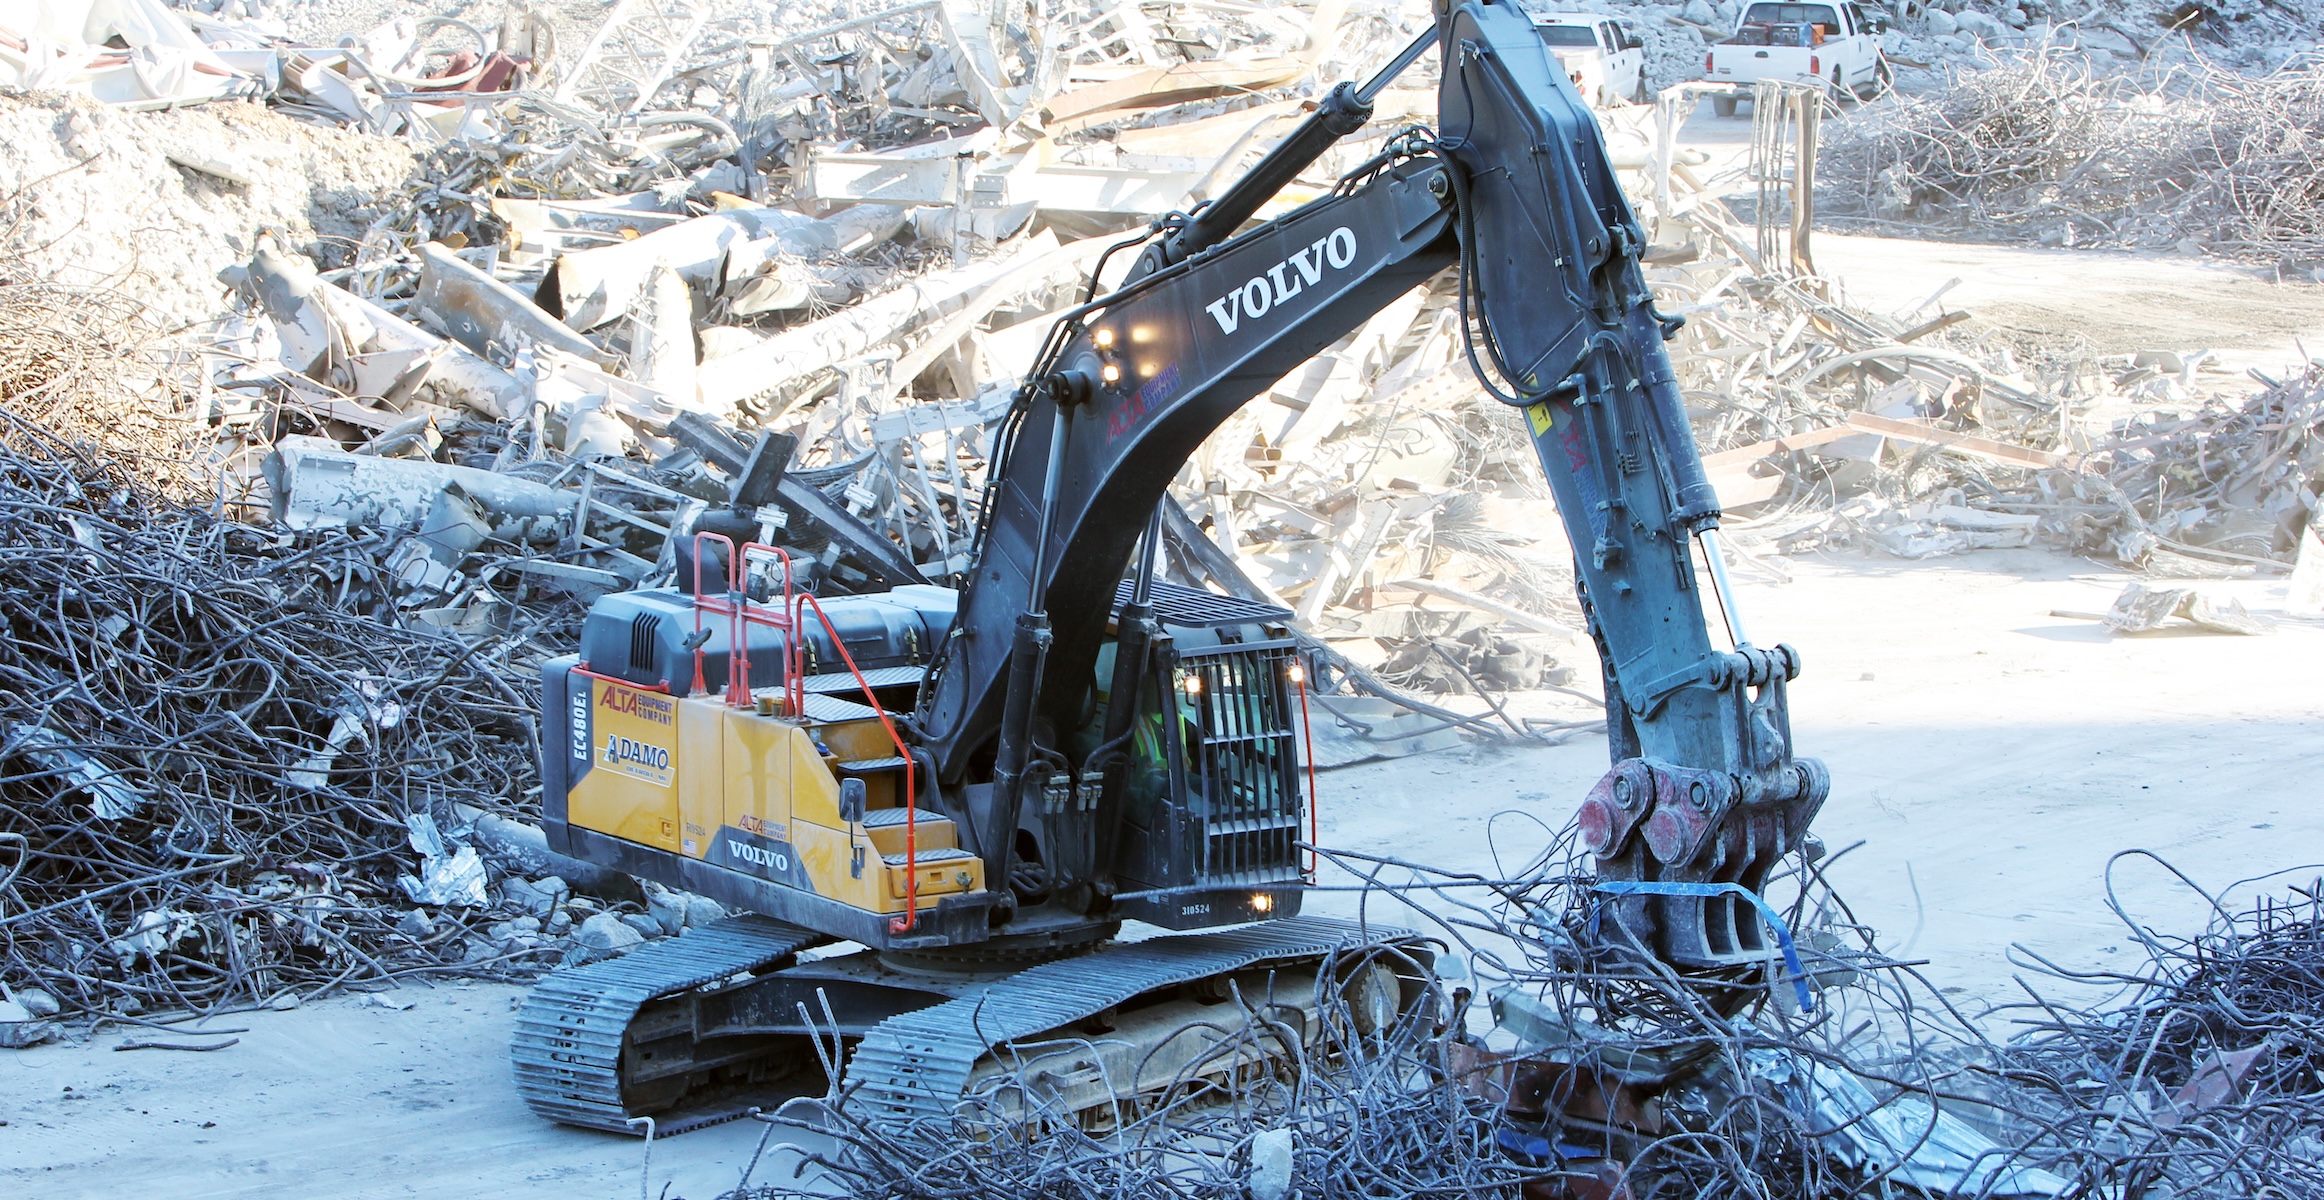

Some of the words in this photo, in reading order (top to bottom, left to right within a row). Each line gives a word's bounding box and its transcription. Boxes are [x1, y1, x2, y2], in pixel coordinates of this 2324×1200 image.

[1205, 226, 1357, 336] VOLVO
[1106, 390, 1146, 446] ALTA
[1140, 360, 1179, 399] EQUIPMENT
[1144, 373, 1182, 413] COMPANY
[599, 685, 637, 717] ALTA
[638, 693, 672, 714] EQUIPMENT
[638, 706, 672, 727] COMPANY
[603, 733, 669, 771] ADAMO
[738, 814, 765, 835] ALTA
[727, 839, 788, 872] VOLVO
[1181, 903, 1210, 916] 310524
